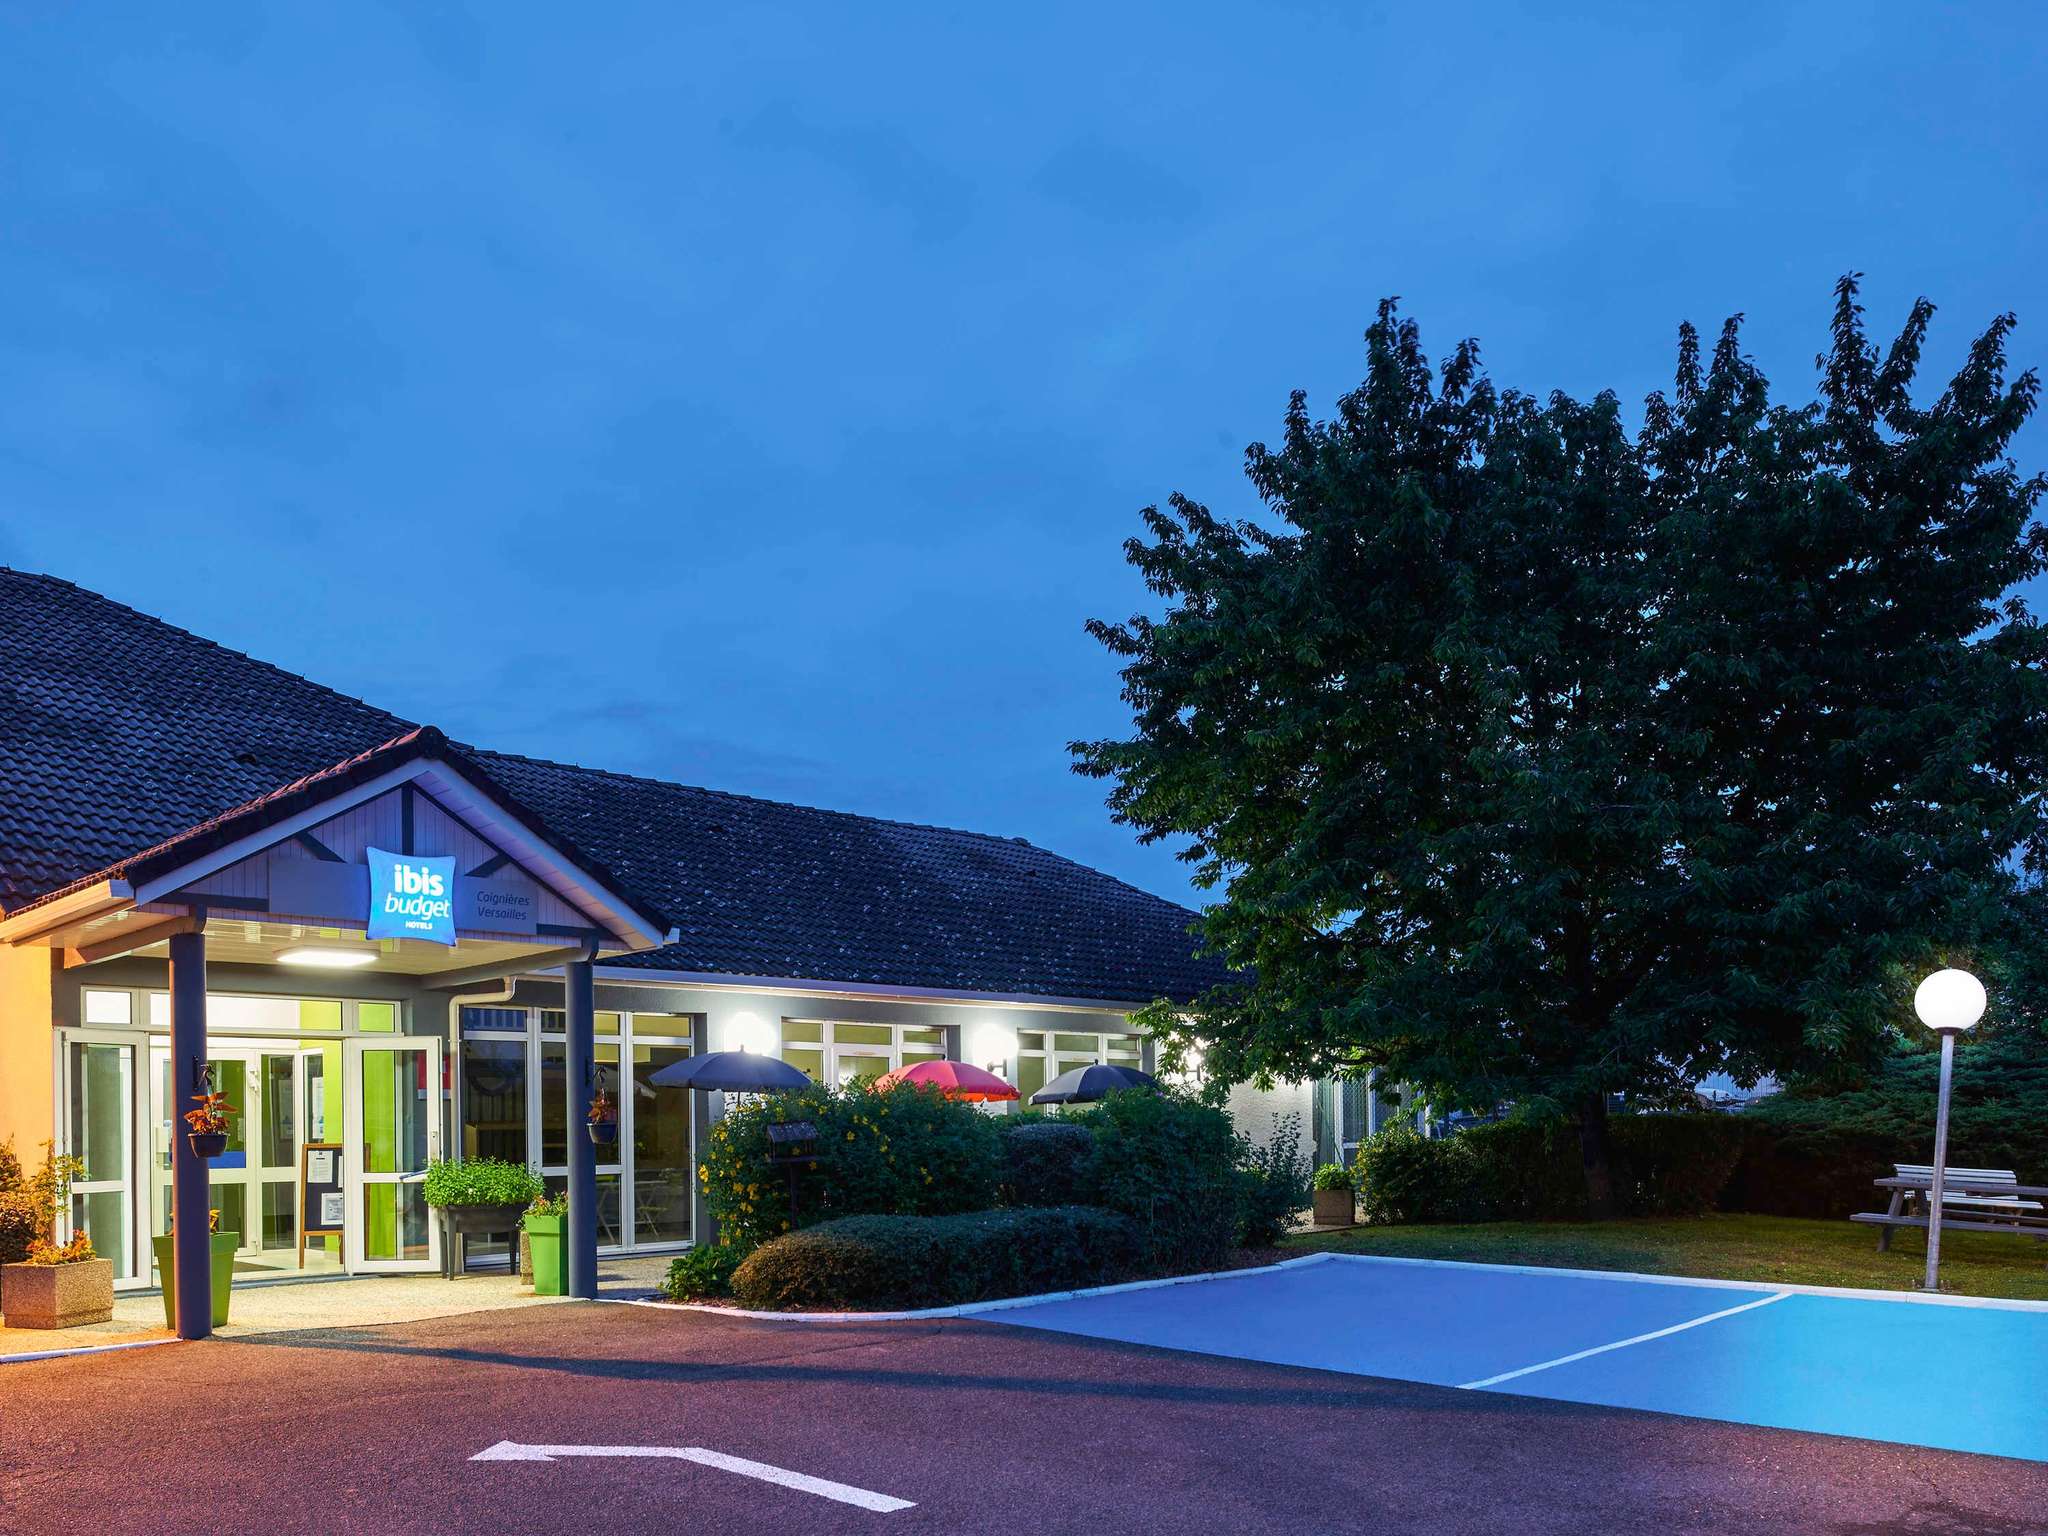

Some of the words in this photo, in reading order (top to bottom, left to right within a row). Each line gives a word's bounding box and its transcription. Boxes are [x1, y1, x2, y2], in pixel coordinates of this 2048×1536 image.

[394, 864, 444, 896] ibis
[385, 892, 450, 920] budget
[477, 891, 530, 906] Coignières
[478, 907, 528, 920] Versailles
